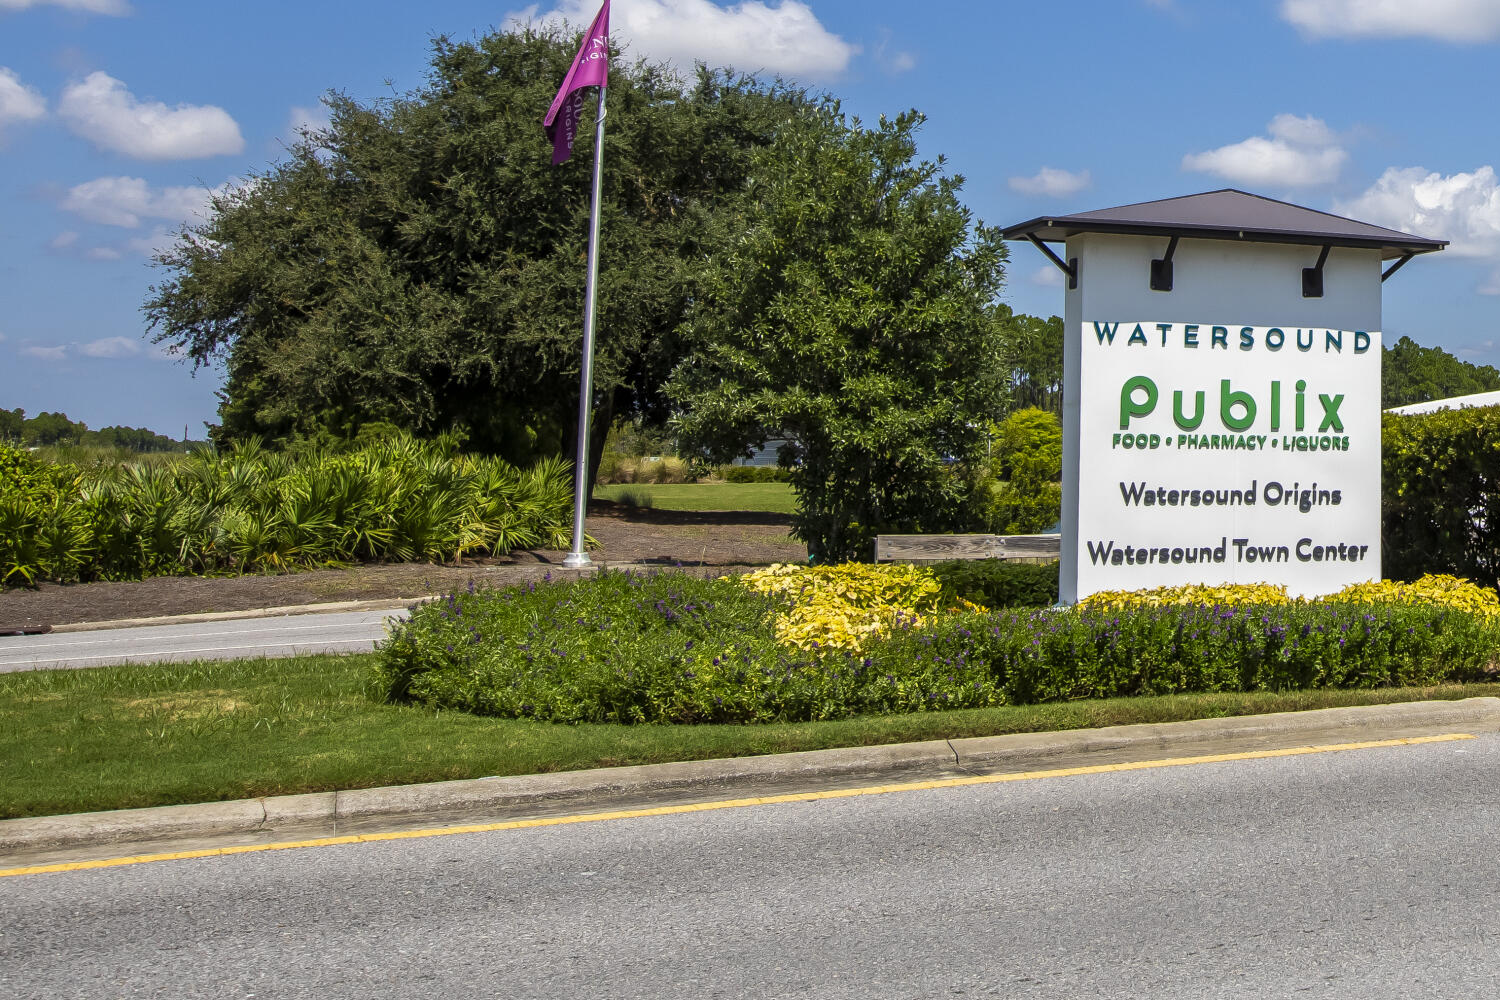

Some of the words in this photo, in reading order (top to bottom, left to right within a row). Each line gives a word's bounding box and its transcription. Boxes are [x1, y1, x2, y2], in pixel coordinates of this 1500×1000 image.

[1093, 321, 1371, 354] WATERSOUND
[1119, 375, 1345, 433] Publix
[1112, 433, 1161, 450] FOOD
[1177, 434, 1267, 451] PHARMACY
[1282, 436, 1350, 452] LIQUORS
[1119, 480, 1257, 507] Watersound
[1263, 481, 1342, 513] Origins
[1087, 537, 1227, 566] Watersound
[1232, 538, 1290, 564] Town
[1295, 538, 1369, 563] Center
